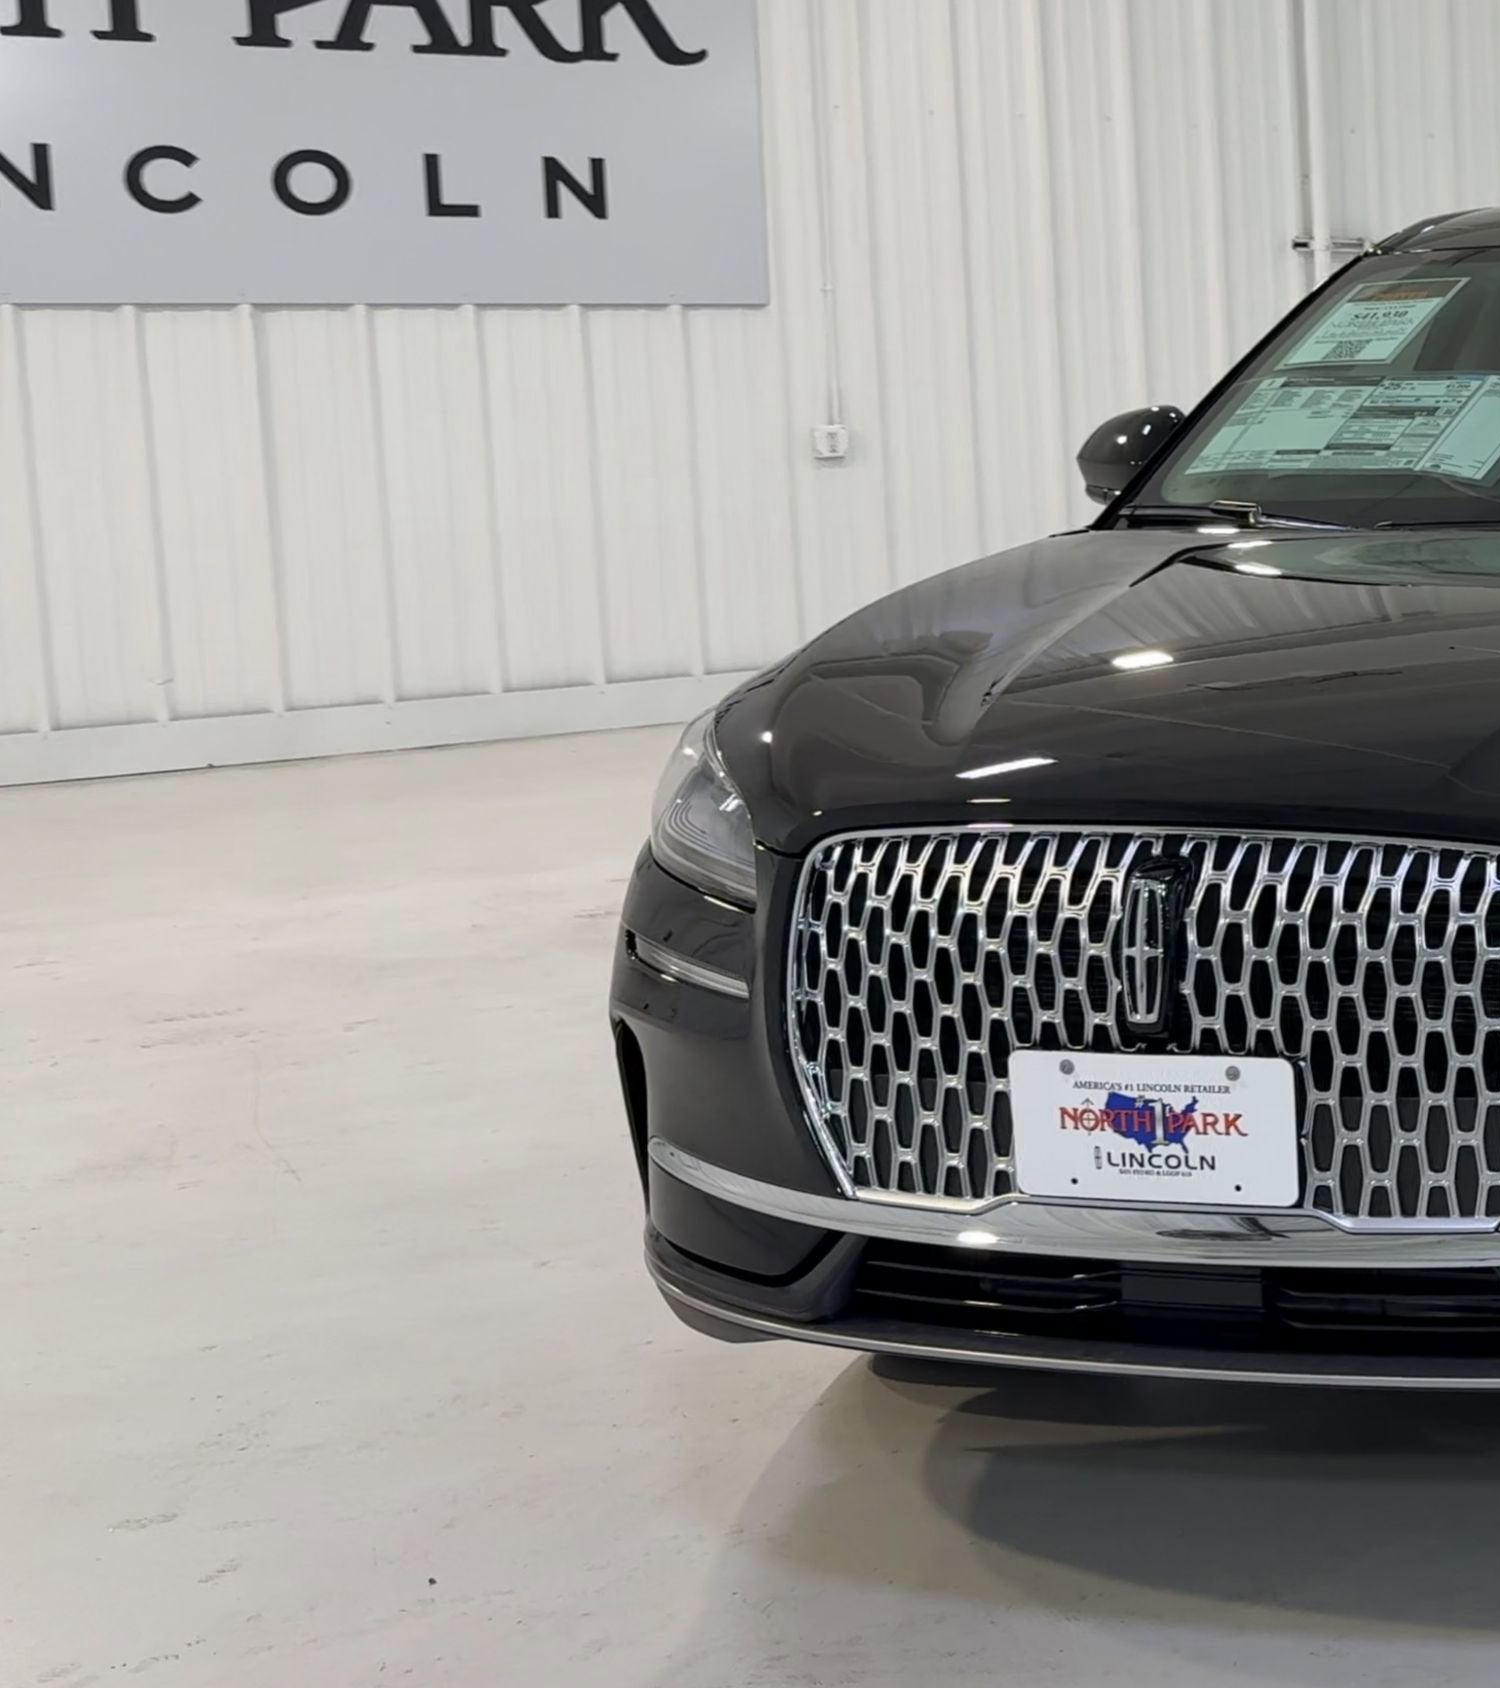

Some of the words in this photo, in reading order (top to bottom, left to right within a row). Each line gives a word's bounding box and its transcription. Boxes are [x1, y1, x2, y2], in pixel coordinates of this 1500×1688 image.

[1072, 1080, 1122, 1091] AMERICA'S
[1124, 1083, 1134, 1091] #1
[1136, 1083, 1182, 1093] LINCOLN
[1183, 1084, 1231, 1094] RETAILER
[1059, 1107, 1152, 1132] NORTH
[1167, 1111, 1249, 1136] PARK
[1106, 1152, 1216, 1171] LINCOLN
